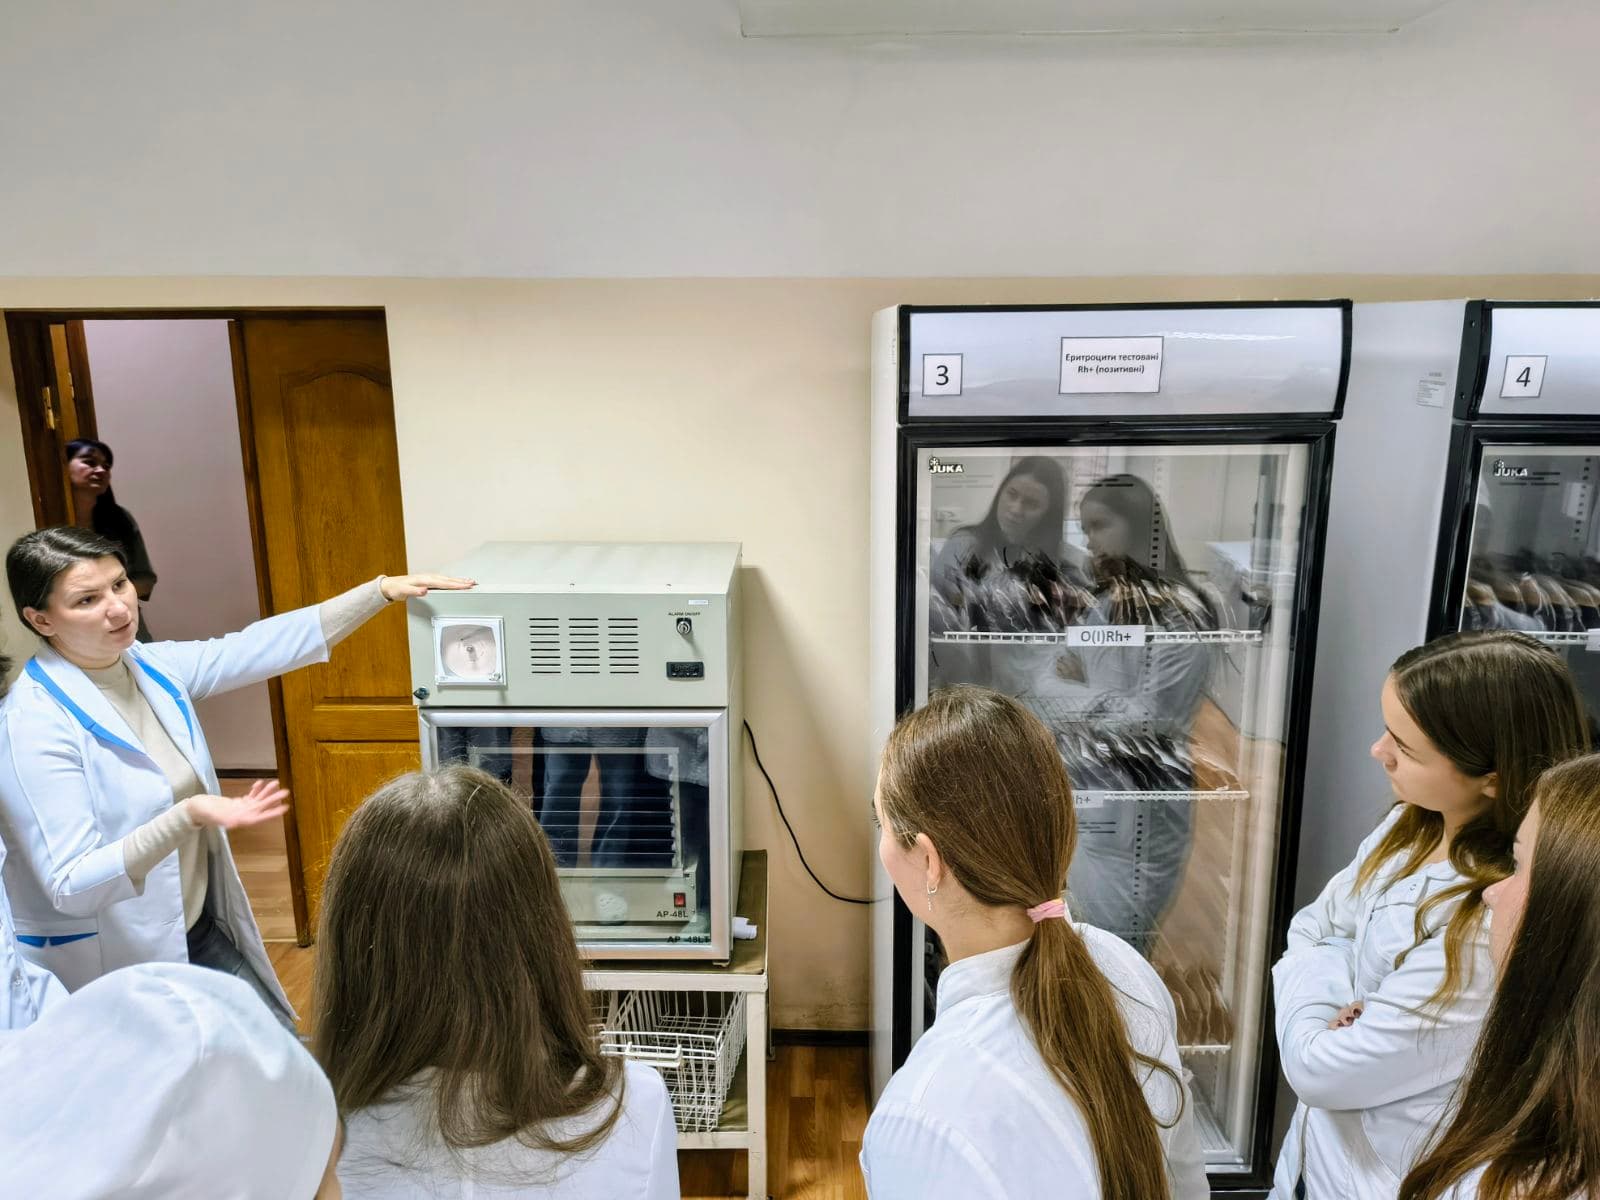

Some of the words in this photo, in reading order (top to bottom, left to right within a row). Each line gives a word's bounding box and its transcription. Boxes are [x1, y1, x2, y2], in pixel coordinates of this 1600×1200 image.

[1065, 353, 1116, 363] Еритроцити
[1119, 352, 1159, 361] тестовані
[1078, 365, 1093, 374] Rh+
[1095, 365, 1145, 374] (позитивні)
[935, 364, 949, 386] 3
[1516, 366, 1531, 387] 4
[929, 464, 964, 473] JUKA
[1494, 467, 1528, 477] JUKA
[656, 910, 688, 918] AP-48L
